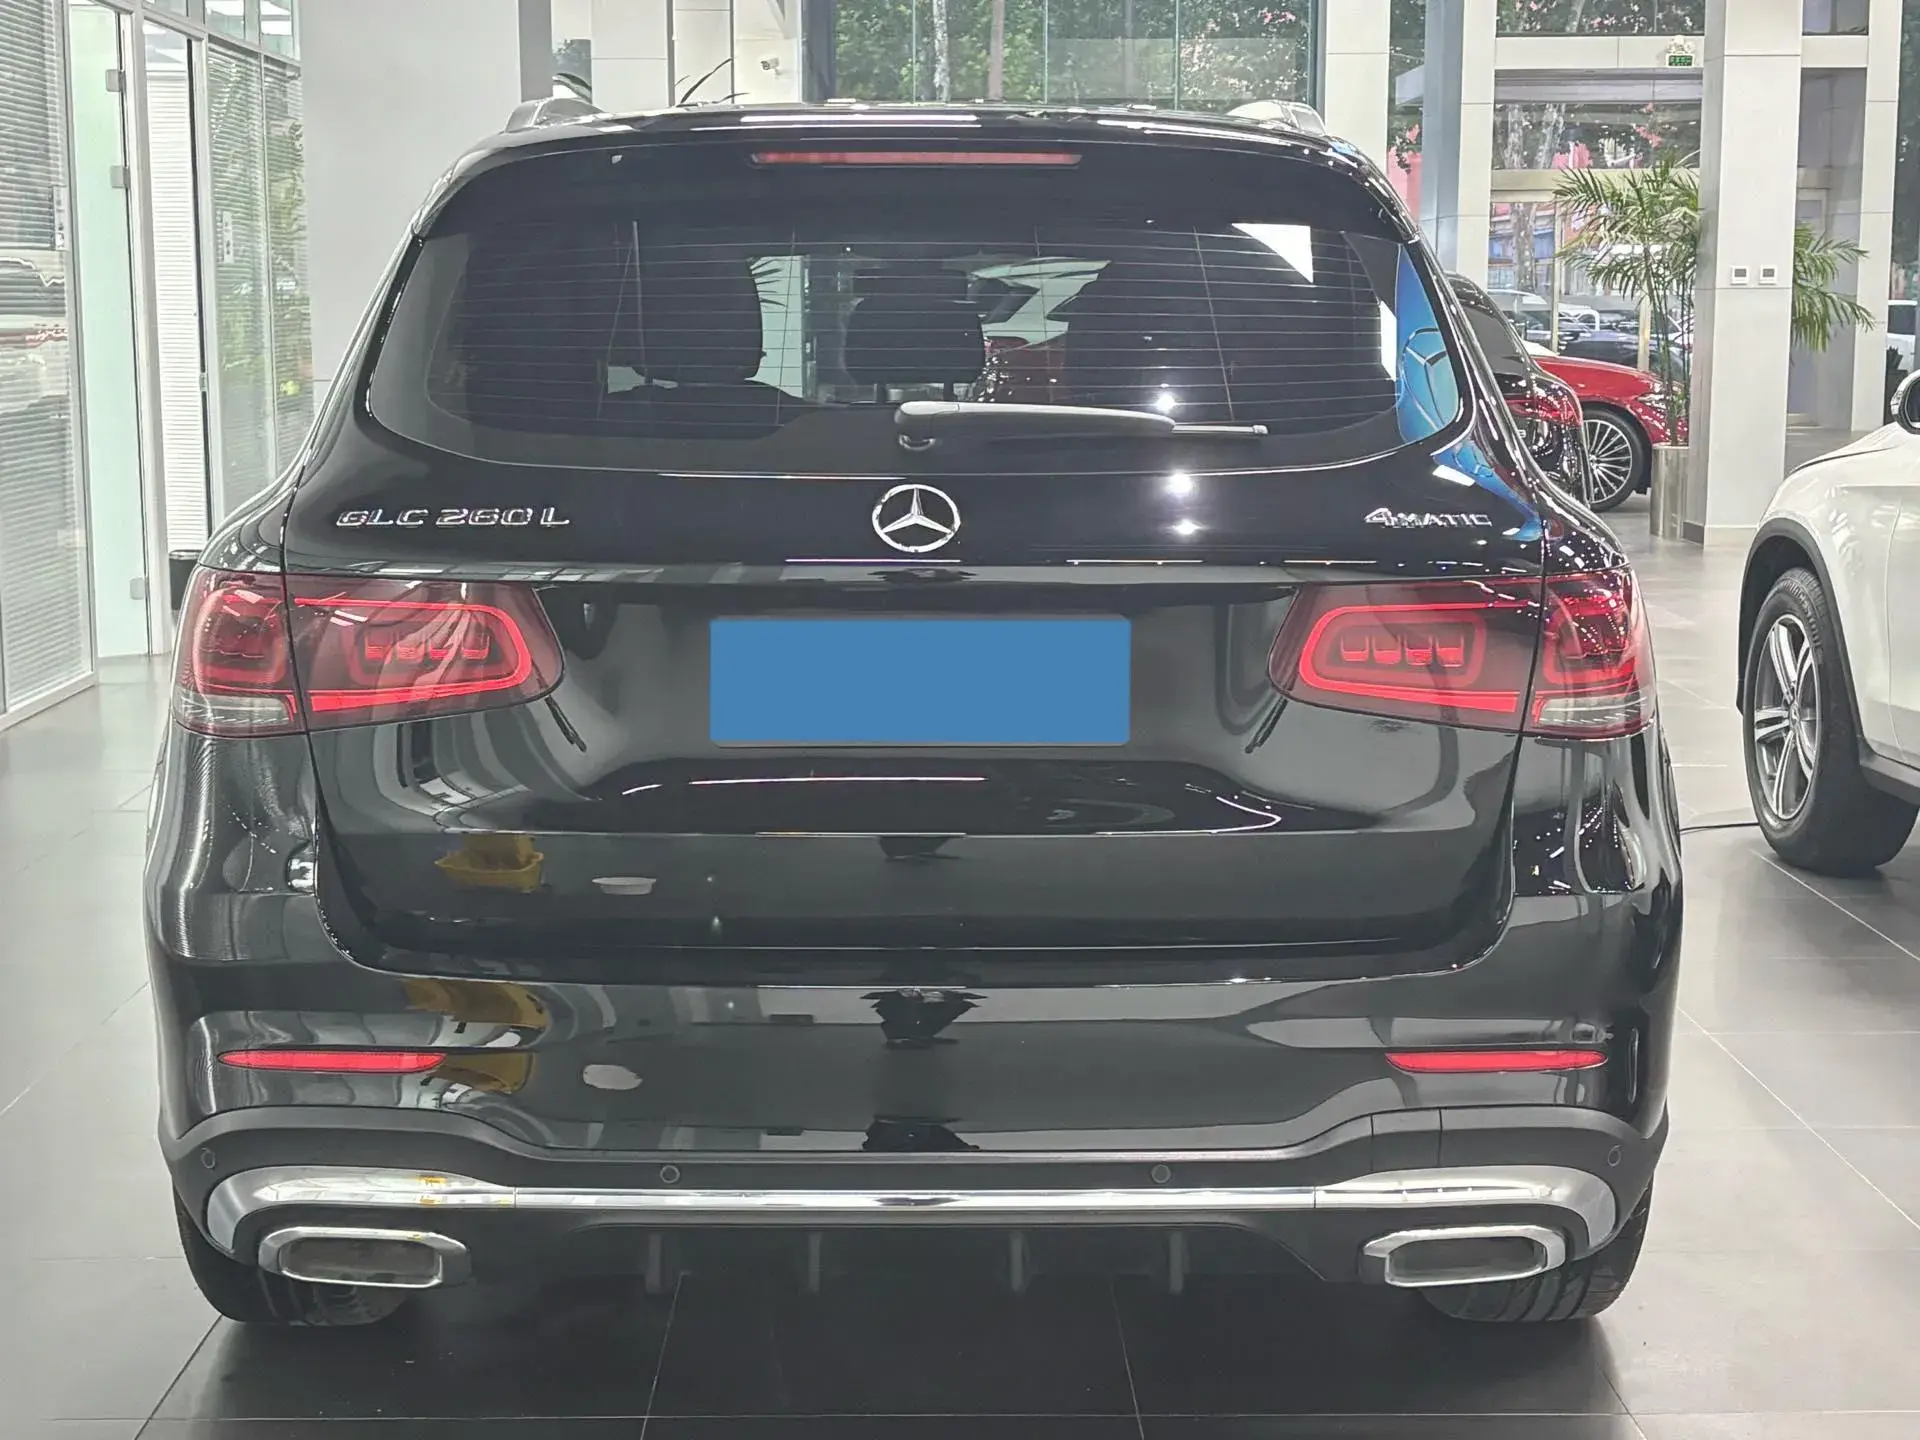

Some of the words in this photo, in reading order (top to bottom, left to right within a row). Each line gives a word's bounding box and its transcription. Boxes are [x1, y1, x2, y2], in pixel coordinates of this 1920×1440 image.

[336, 508, 429, 527] GLC
[435, 508, 533, 527] 260
[540, 507, 570, 526] L
[1363, 507, 1493, 528] 4MATIC
